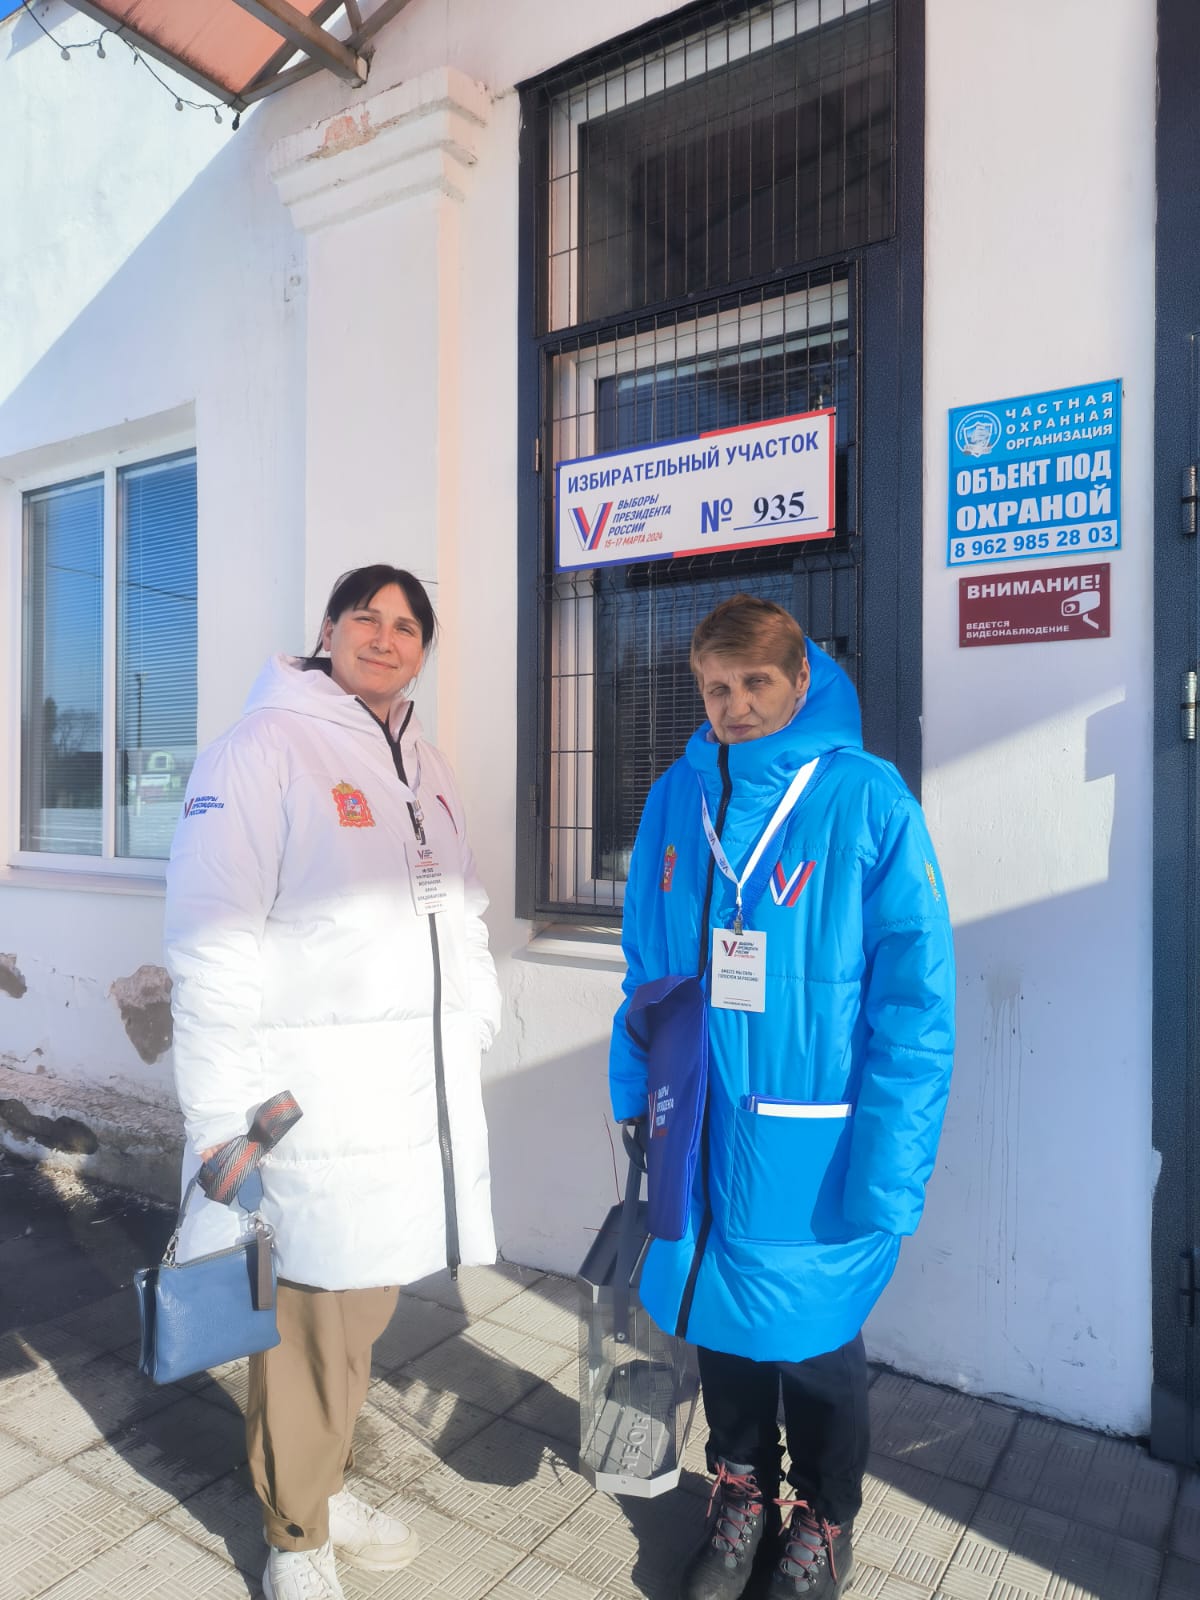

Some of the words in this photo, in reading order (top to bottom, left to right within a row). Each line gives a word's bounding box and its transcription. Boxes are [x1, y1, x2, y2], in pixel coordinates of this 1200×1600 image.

[1005, 391, 1113, 419] ЧАСТНАЯ
[1005, 408, 1113, 435] ОХРАННАЯ
[1005, 423, 1113, 450] ОРГАНИЗАЦИЯ
[568, 445, 720, 493] ИЗБИРАТЕЛЬНЫЙ
[726, 431, 819, 465] УЧАСТОК
[956, 459, 1050, 496] ОБЪЕКТ
[1056, 449, 1112, 482] ПОД
[612, 505, 671, 523] ПРЕЗИДЕНТА
[617, 494, 659, 510] ВЫБОРЫ
[753, 491, 805, 524] 935
[956, 483, 1111, 532] ОХРАНОЙ
[608, 523, 645, 537] РОССИИ
[622, 535, 646, 546] МАРТА
[646, 531, 663, 543] 2024
[954, 542, 965, 558] 8
[972, 537, 1006, 556] 962
[1013, 533, 1049, 551] 985
[1056, 529, 1081, 547] 28
[1088, 525, 1113, 543] 03
[967, 574, 1101, 600] ВНИМАНИЕ!
[966, 620, 1010, 631] ВЕДЕТСЯ
[966, 625, 1070, 639] ВИДЕОНАБЛЮДЕНИЕ
